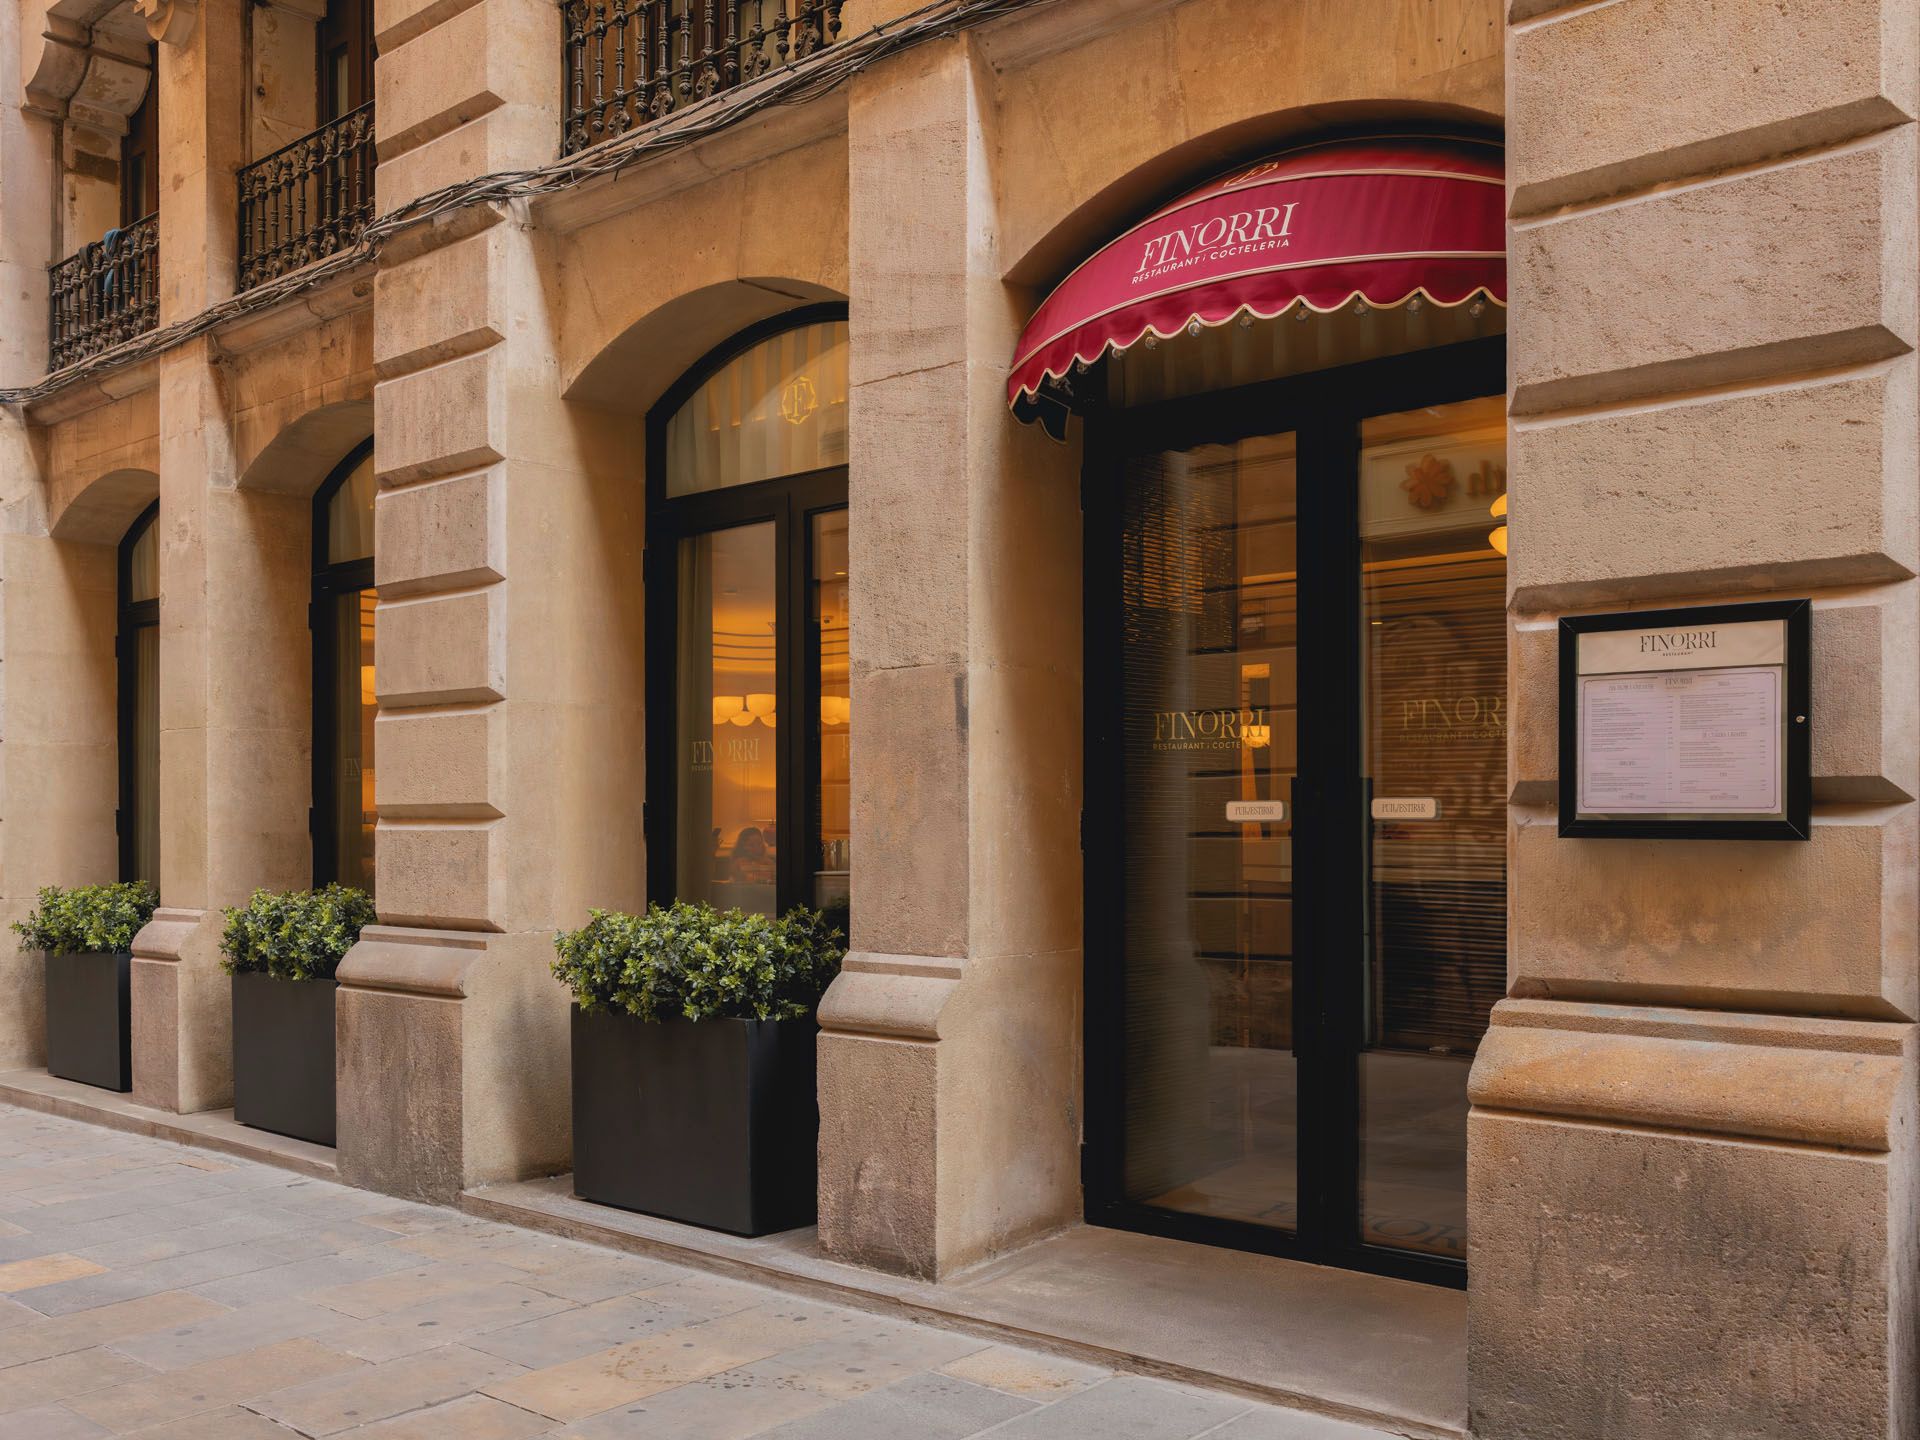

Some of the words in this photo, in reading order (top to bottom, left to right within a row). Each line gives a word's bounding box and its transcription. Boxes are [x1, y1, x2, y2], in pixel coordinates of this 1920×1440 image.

[1135, 202, 1300, 273] FINORRI
[1132, 256, 1201, 285] RESTAURANT
[1210, 238, 1290, 261] COCTELERIA
[1640, 630, 1718, 653] FINORRI
[1154, 708, 1266, 740] FINORRI
[1399, 696, 1507, 730] FINOR
[1152, 742, 1205, 752] RESTAURANT
